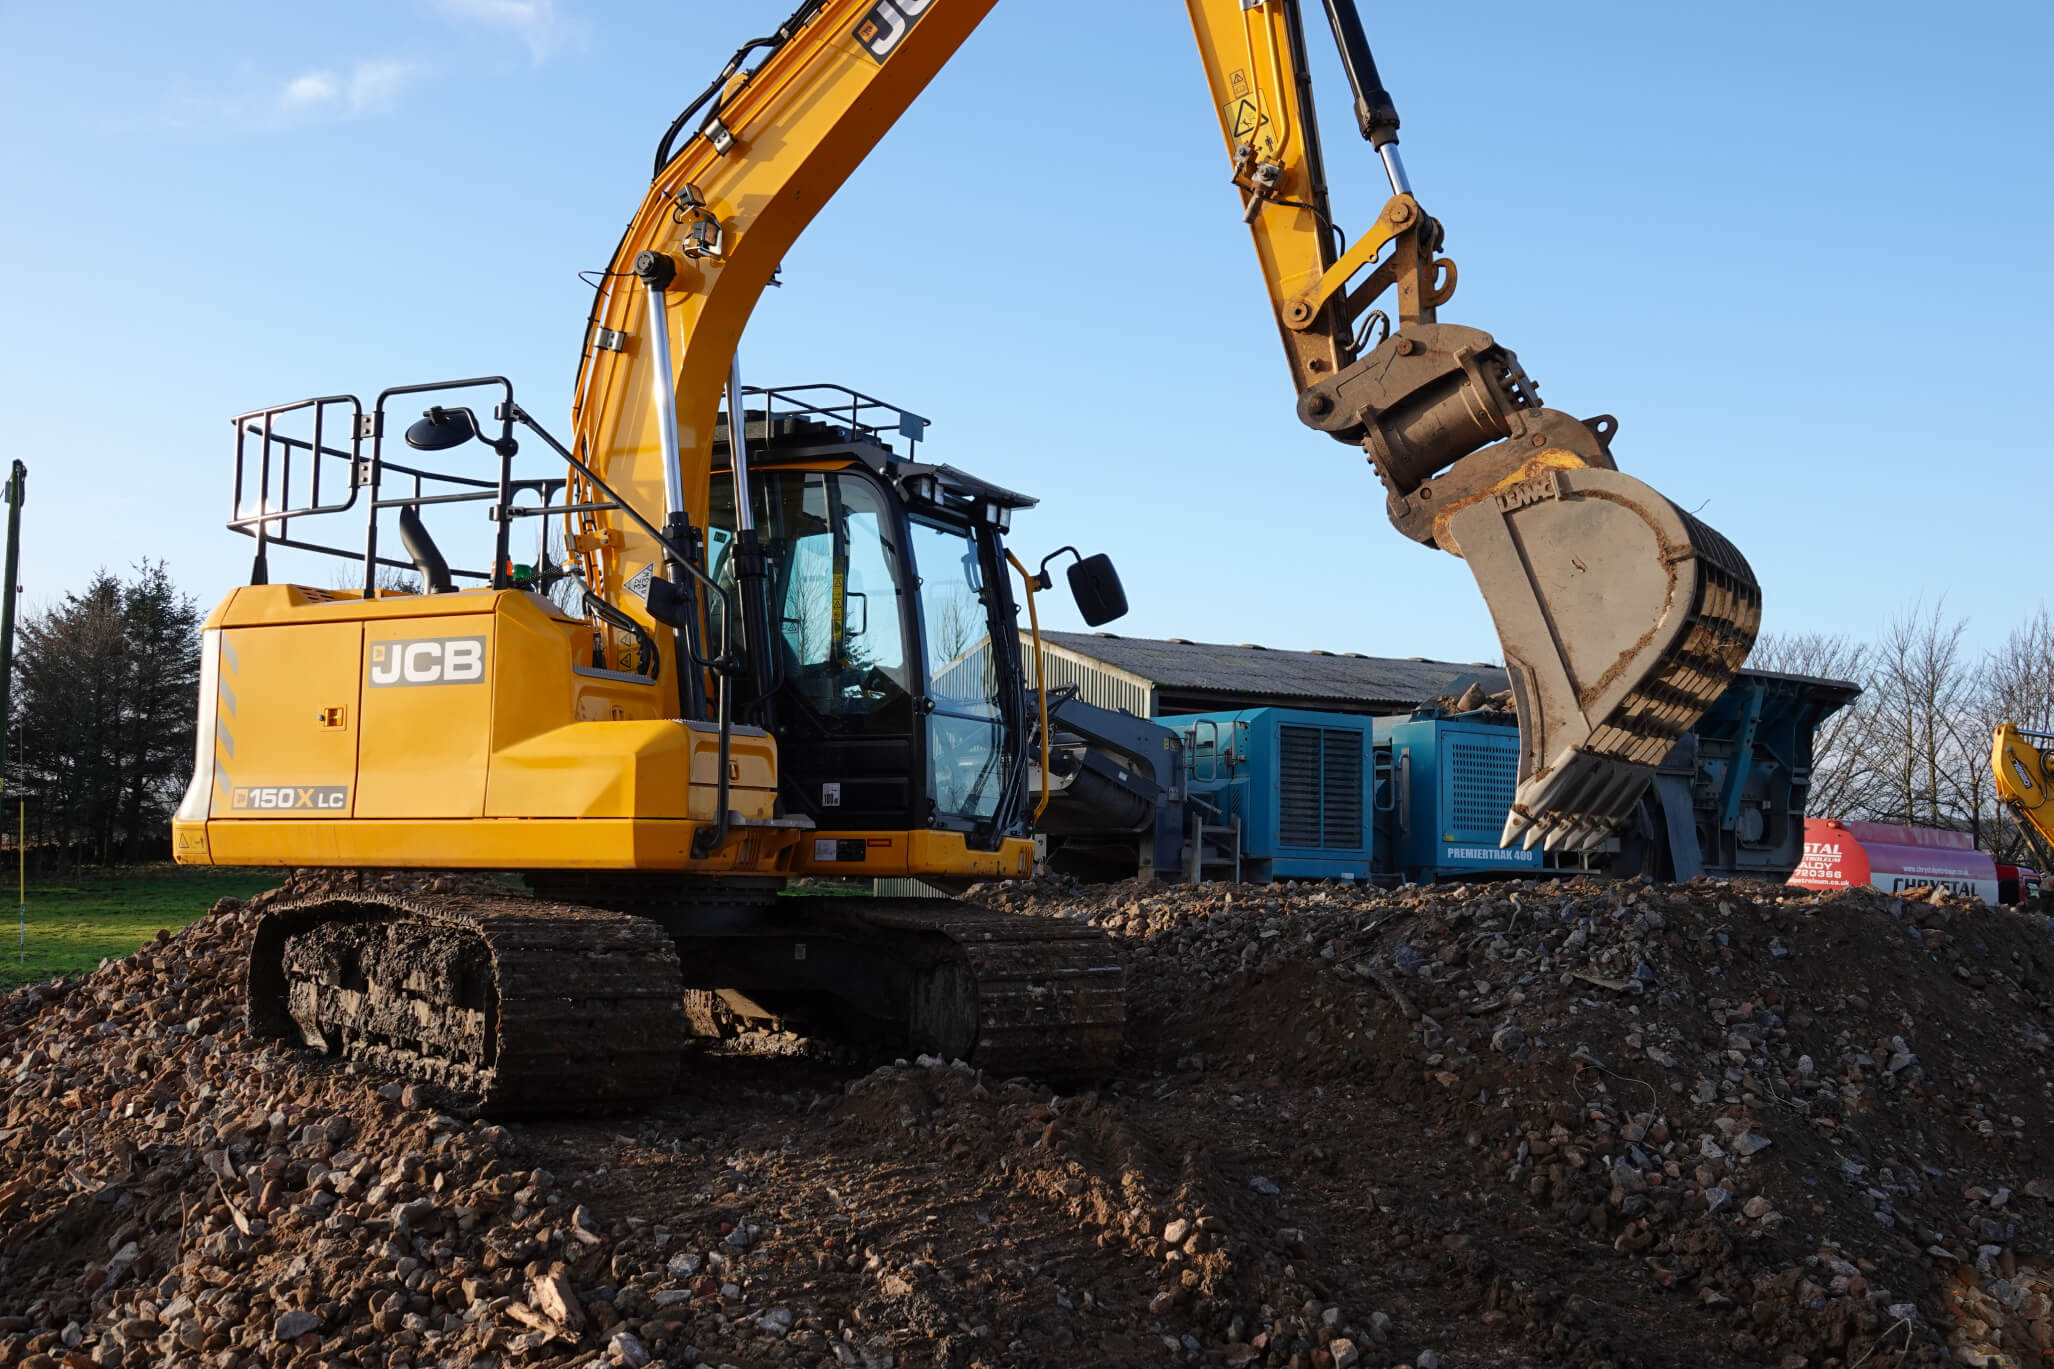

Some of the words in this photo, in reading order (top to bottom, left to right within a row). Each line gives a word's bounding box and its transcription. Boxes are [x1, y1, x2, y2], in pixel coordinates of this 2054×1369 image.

[371, 640, 483, 684] JCB
[318, 792, 344, 808] LC
[1447, 847, 1513, 860] PREMIERTRAK
[1514, 850, 1533, 861] 400
